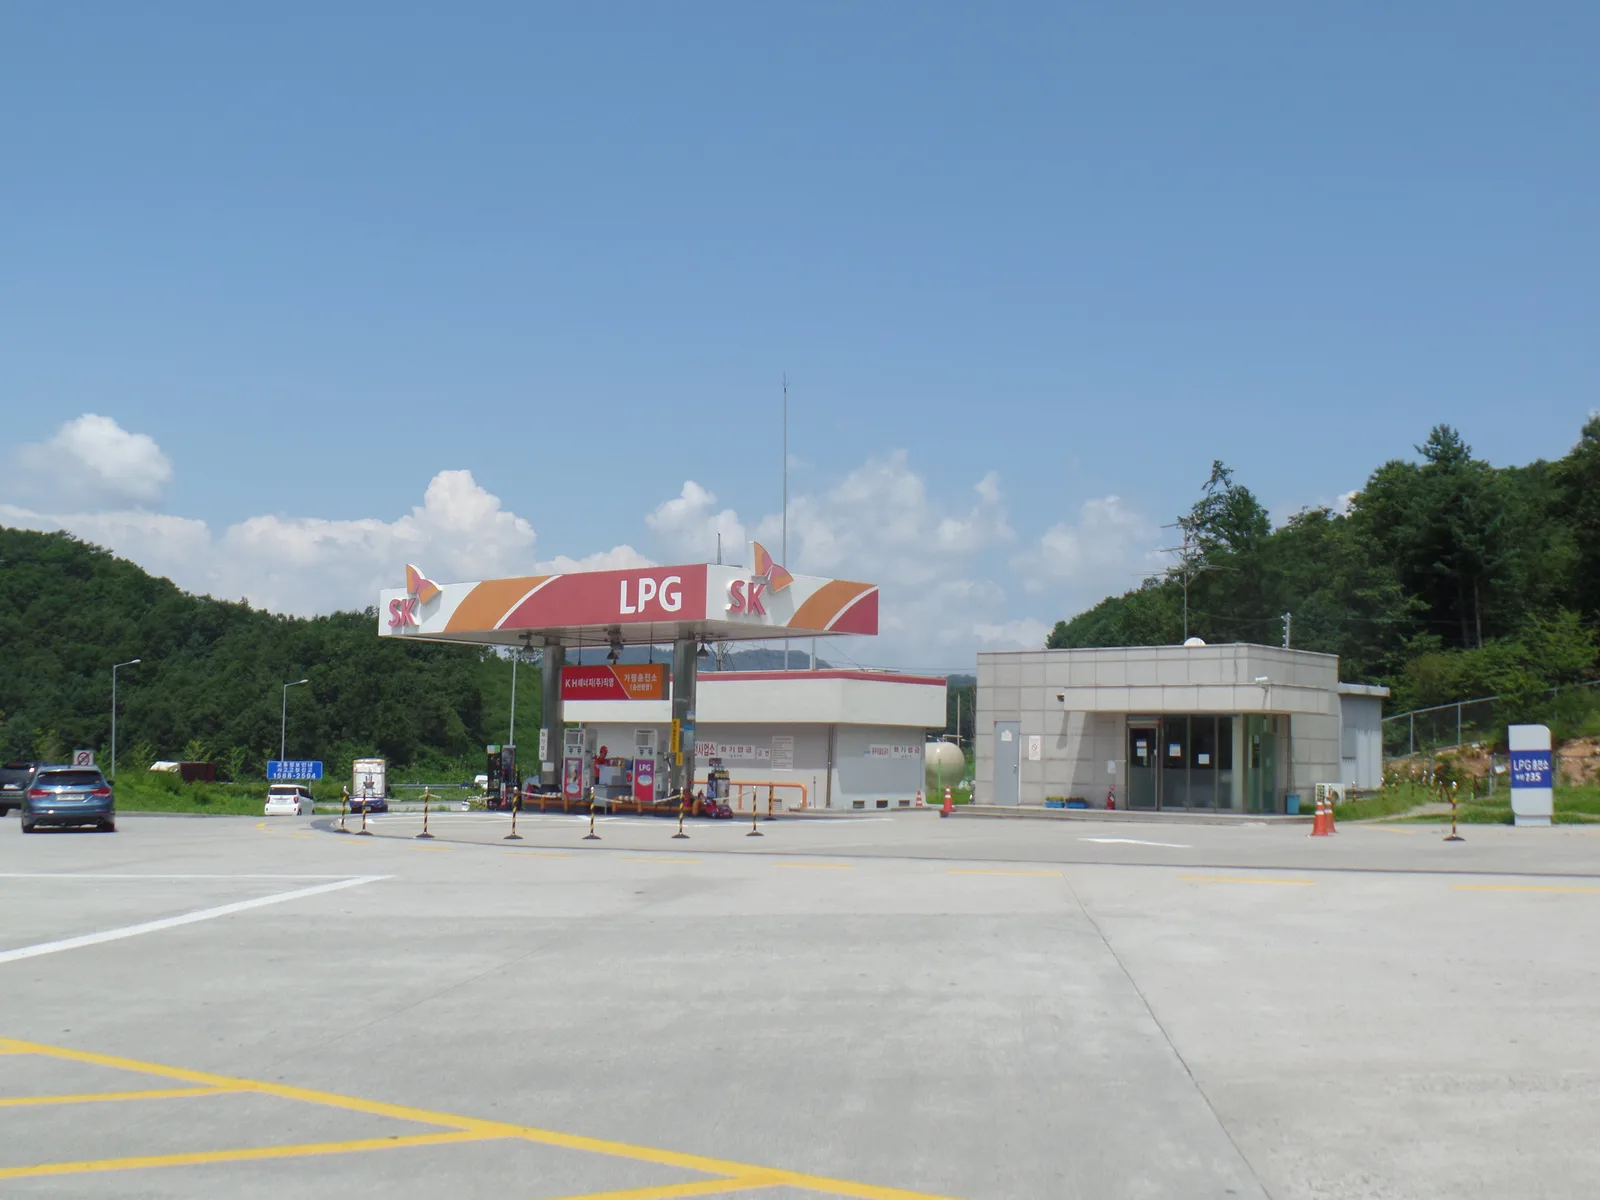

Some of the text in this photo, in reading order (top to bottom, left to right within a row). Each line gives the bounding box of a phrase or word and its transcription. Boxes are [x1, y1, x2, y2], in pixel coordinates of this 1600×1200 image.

[620, 576, 682, 614] LPG
[726, 579, 766, 616] SK
[388, 598, 417, 628] SK
[624, 673, 657, 682] 가평충전소
[696, 743, 715, 756] 사업소
[1525, 772, 1541, 782] 735
